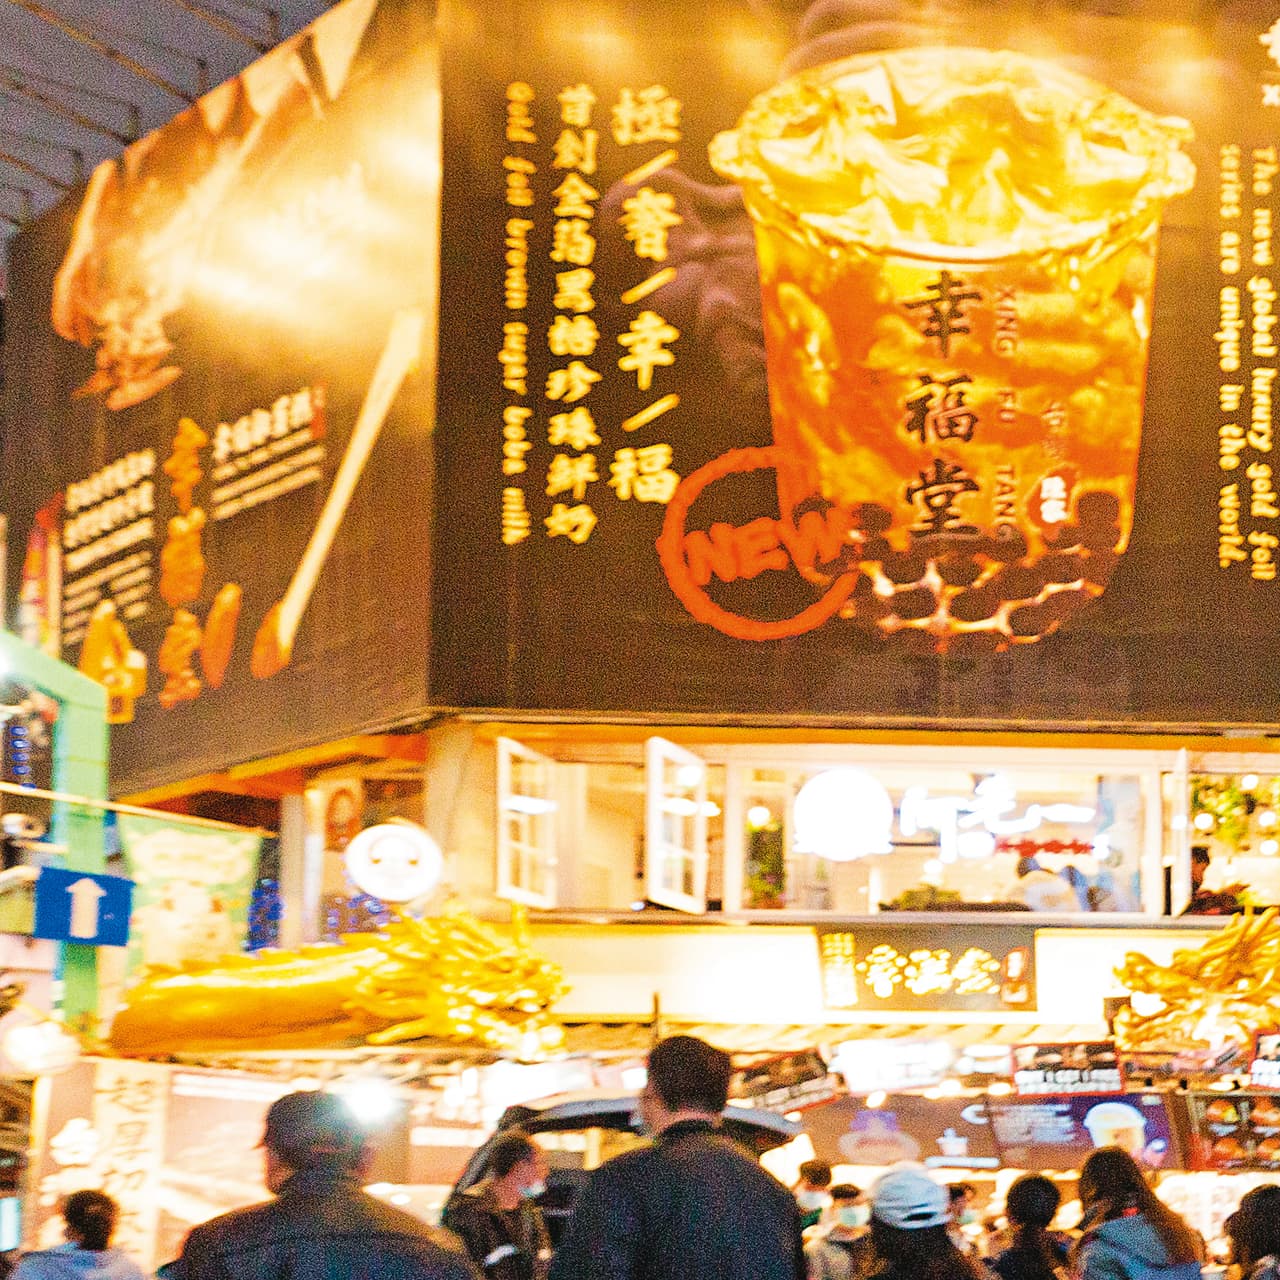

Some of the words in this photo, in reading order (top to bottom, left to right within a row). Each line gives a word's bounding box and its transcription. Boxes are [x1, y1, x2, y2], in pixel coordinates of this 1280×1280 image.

[1250, 146, 1280, 195] The
[1219, 228, 1242, 275] are
[1250, 208, 1273, 266] new
[997, 285, 1016, 357] XING
[1215, 284, 1242, 372] unique
[1246, 276, 1278, 357] global
[498, 321, 529, 396] sugar
[903, 270, 985, 540] 幸福堂
[998, 387, 1017, 424] FU
[1219, 384, 1242, 413] in
[1246, 367, 1278, 452] luxury
[502, 405, 533, 475] boba
[1219, 422, 1246, 470] the
[996, 464, 1018, 543] TANG
[1219, 481, 1246, 568] world.
[1245, 461, 1280, 518] gold
[686, 507, 848, 586] NEW
[1248, 530, 1279, 581] foil
